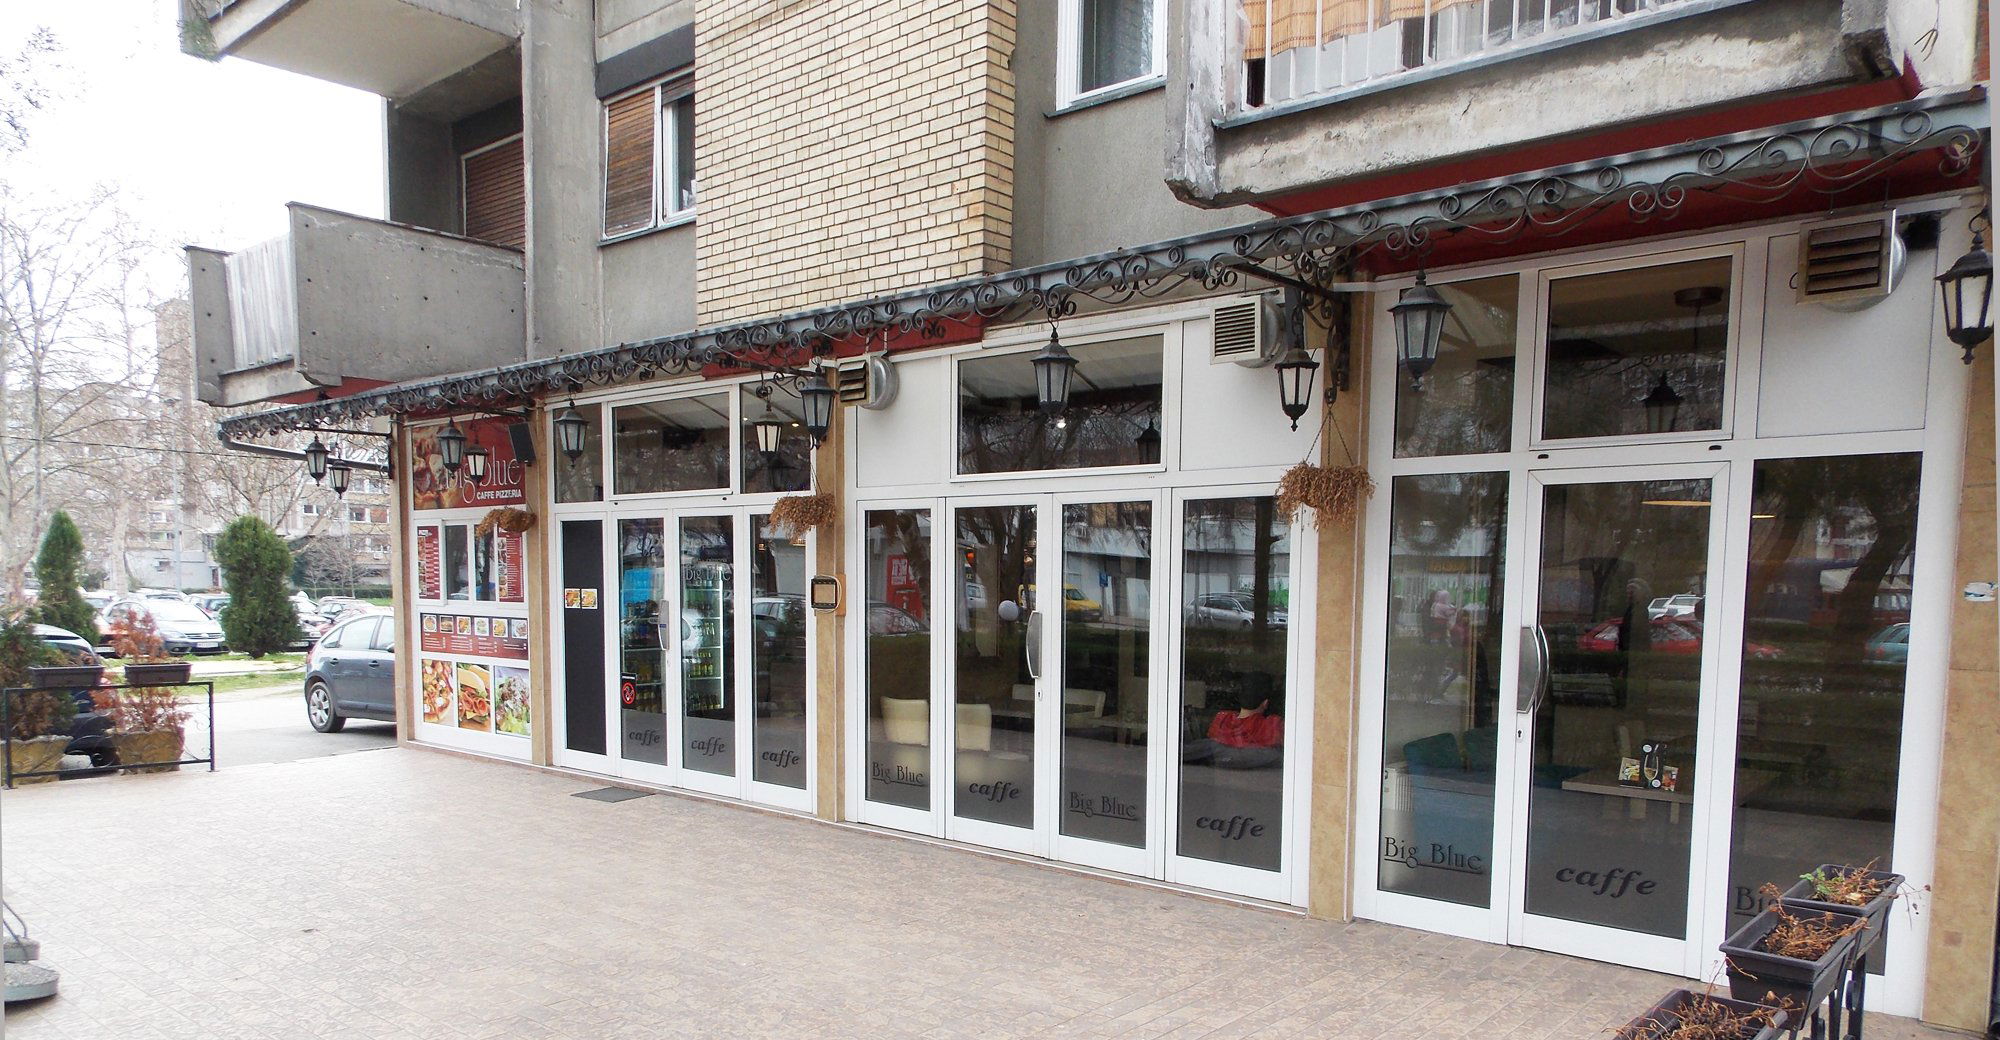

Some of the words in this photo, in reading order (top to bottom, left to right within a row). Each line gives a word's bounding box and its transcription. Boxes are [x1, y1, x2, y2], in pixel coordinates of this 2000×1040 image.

[476, 491, 495, 500] CAFFE
[496, 488, 522, 499] PIZZERIA
[629, 729, 660, 746] caffe
[691, 736, 725, 756] caffe
[762, 749, 799, 768] caffe
[872, 761, 892, 784] Big
[896, 765, 924, 784] Blue
[969, 781, 1020, 803] caffe
[1069, 791, 1094, 817] Big
[1101, 796, 1137, 817] Blue
[1196, 815, 1265, 841] caffe
[1384, 836, 1418, 868] Big
[1430, 843, 1482, 871] Blue
[1556, 867, 1657, 898] caffe
